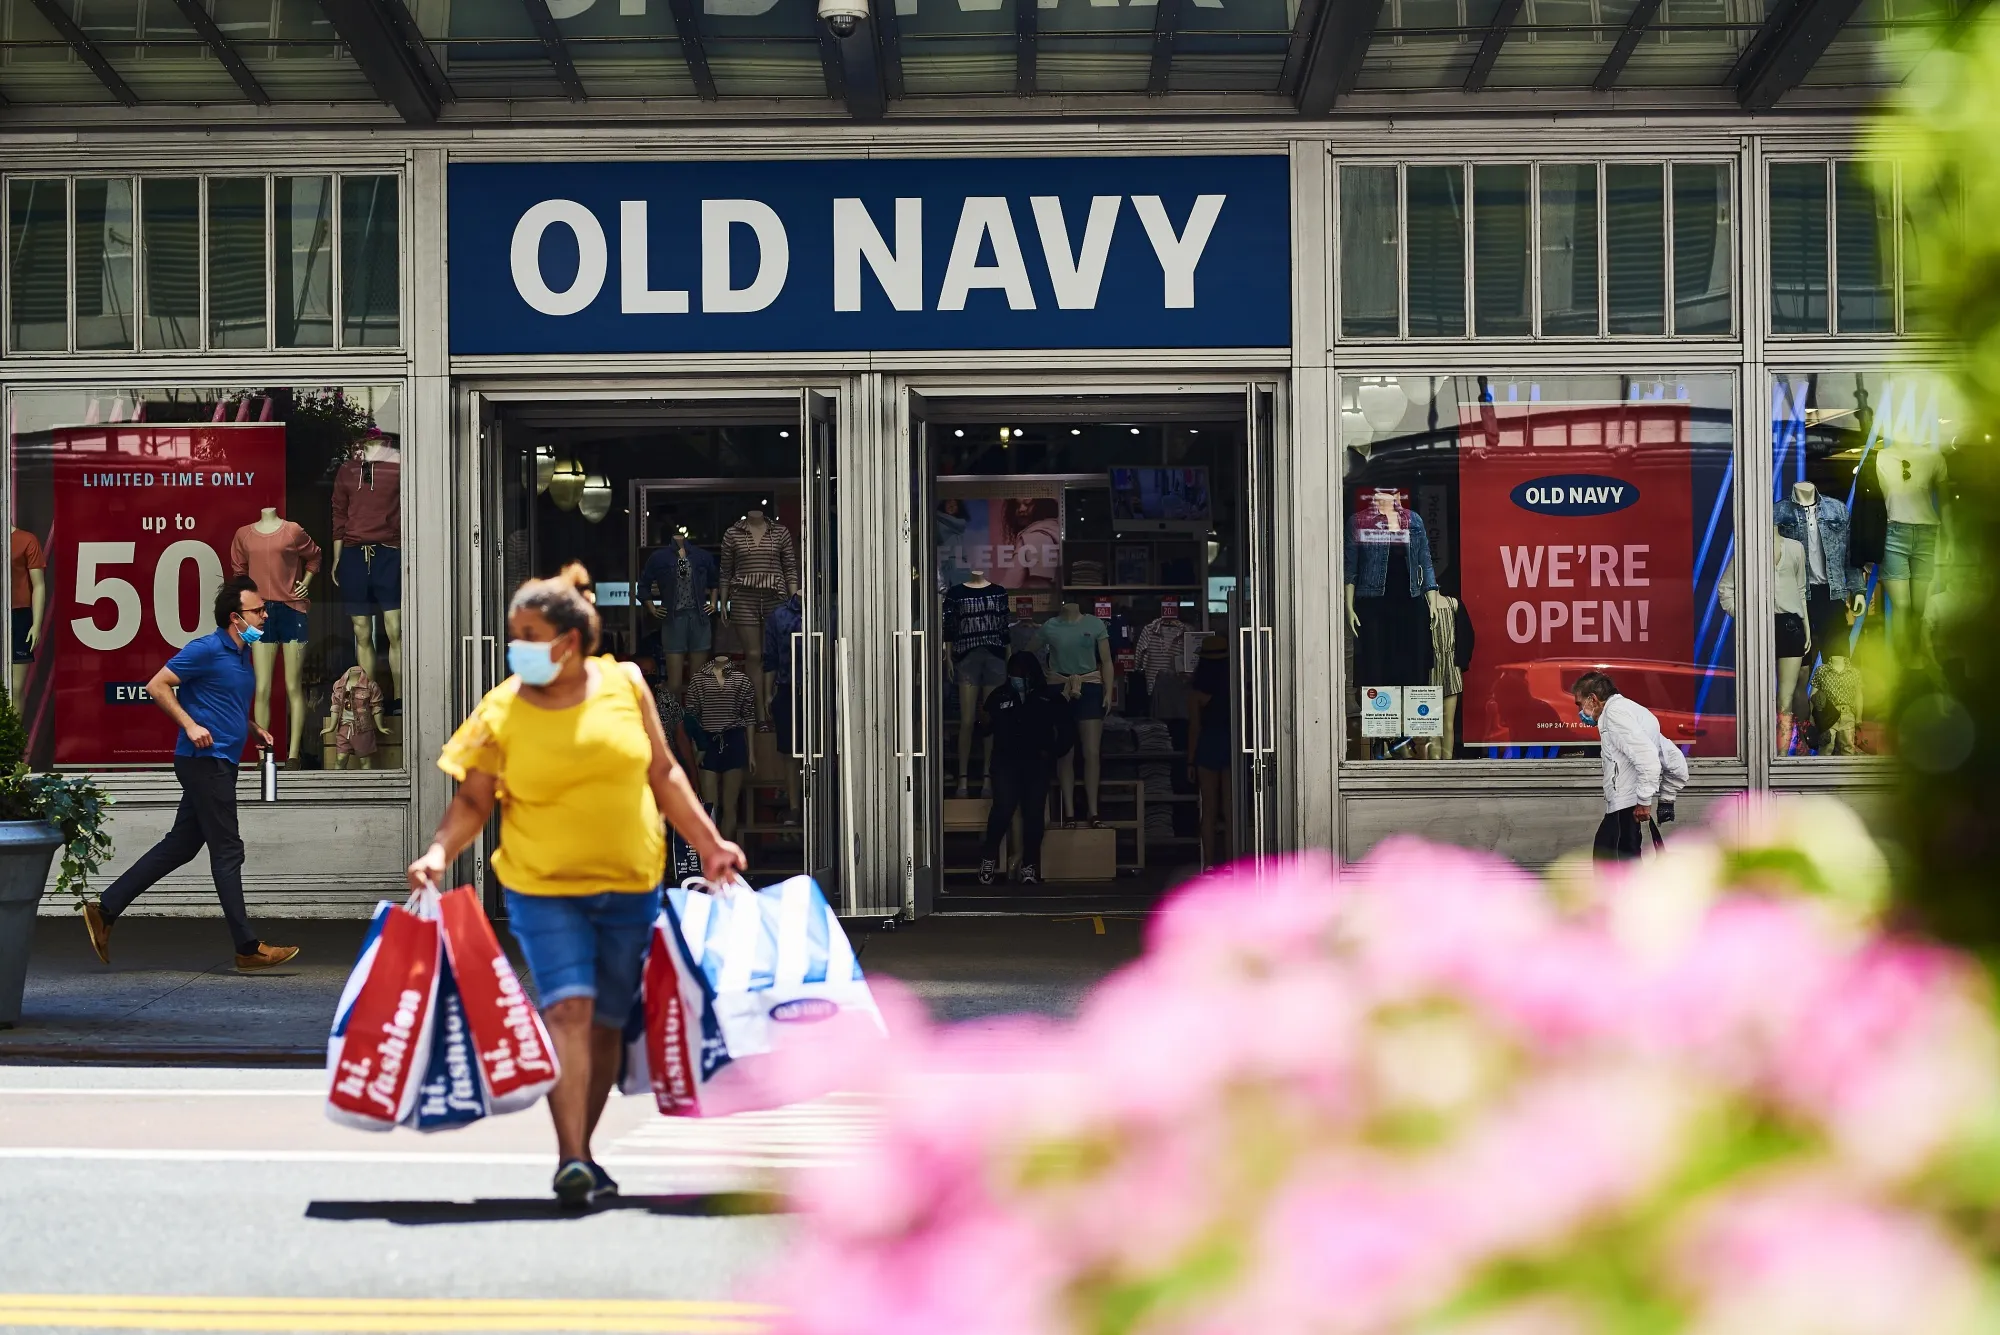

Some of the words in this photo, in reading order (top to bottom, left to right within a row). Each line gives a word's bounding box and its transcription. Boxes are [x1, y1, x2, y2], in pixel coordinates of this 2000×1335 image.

[510, 198, 789, 316] OLD
[833, 194, 1227, 311] NAVY
[83, 473, 154, 487] LIMITED
[161, 472, 204, 486] TIME
[211, 471, 255, 486] ONLY
[1525, 487, 1565, 504] OLD
[1569, 486, 1624, 504] NAVY
[142, 516, 167, 534] up
[175, 513, 196, 530] to
[936, 544, 1059, 569] FLEECE
[1499, 544, 1650, 588] WE'RE
[70, 539, 224, 651] 50
[609, 590, 629, 598] FITT
[1506, 600, 1650, 644] OPEN!
[116, 686, 180, 700] EVET
[1554, 721, 1569, 729] 24/7
[677, 859, 688, 874] hi.
[685, 840, 700, 873] fashi
[491, 956, 551, 1073] fashion
[367, 989, 422, 1115] fashion
[483, 1038, 516, 1083] hi.
[336, 1057, 372, 1099] hi.
[420, 1076, 448, 1116] hi.
